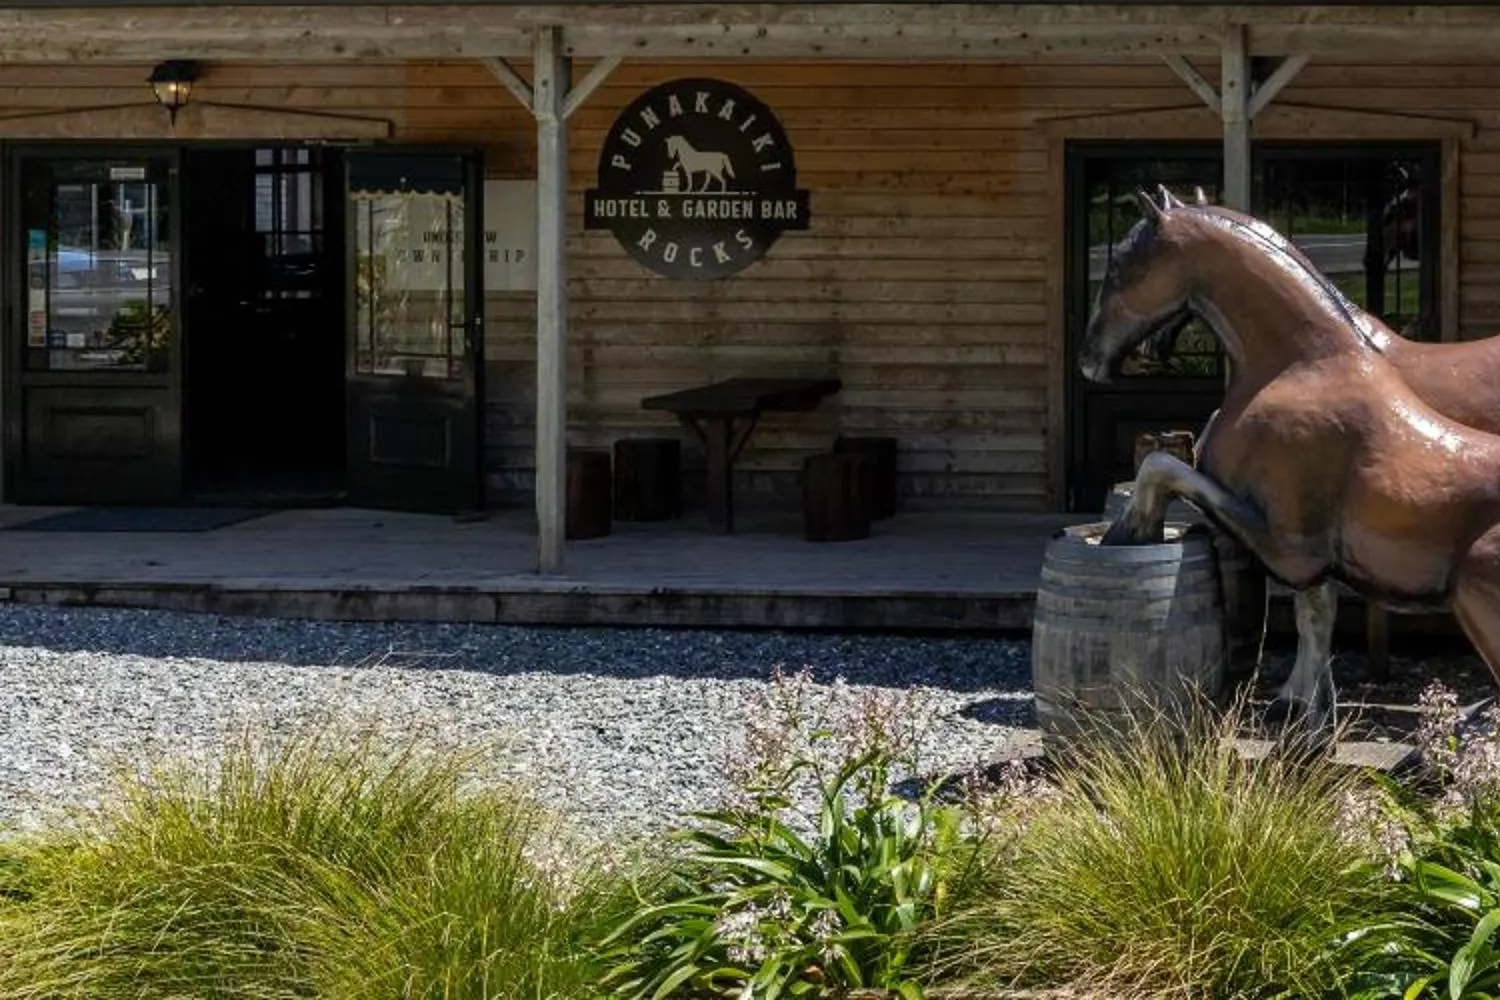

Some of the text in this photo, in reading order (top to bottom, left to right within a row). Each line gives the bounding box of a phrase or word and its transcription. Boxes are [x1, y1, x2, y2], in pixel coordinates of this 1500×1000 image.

[611, 91, 781, 172] PUNAKAIKI
[593, 200, 798, 220] HOTEL & GARDEN BAR
[637, 228, 754, 268] ROCKS
